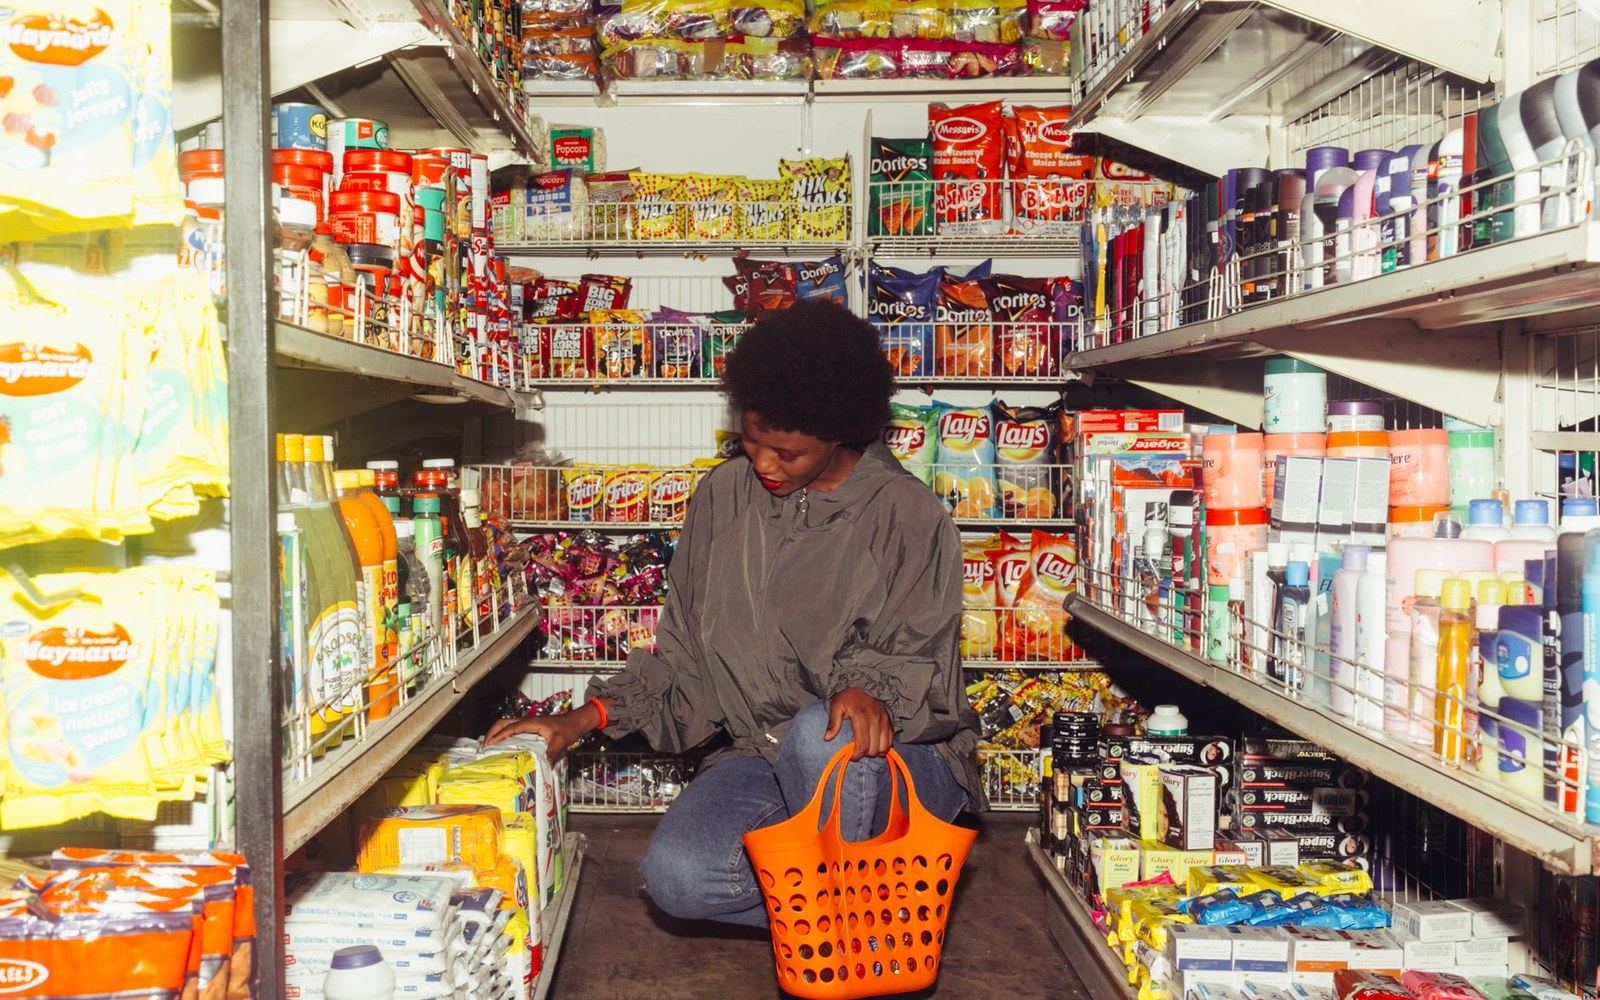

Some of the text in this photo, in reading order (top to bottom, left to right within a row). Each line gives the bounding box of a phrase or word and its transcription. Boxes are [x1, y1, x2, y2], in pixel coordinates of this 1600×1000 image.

[940, 125, 980, 135] Messaris
[556, 144, 588, 156] Popcorn
[871, 157, 927, 174] Doritos
[952, 157, 976, 165] Snack
[1058, 159, 1082, 167] Snack
[793, 177, 828, 198] NIK
[800, 264, 838, 280] Doritos
[589, 286, 616, 301] BIG
[586, 297, 614, 308] KORN
[993, 293, 1047, 313] Doritos
[868, 299, 926, 319] Doritos
[936, 305, 992, 322] Doritos
[660, 327, 694, 338] Doritos
[553, 341, 581, 350] KORN
[553, 350, 581, 358] BITES
[941, 414, 990, 443] Lay's
[885, 424, 925, 455] ay's
[998, 421, 1046, 448] Lay's
[1135, 440, 1189, 450] Colgate
[607, 480, 644, 504] Fritos
[16, 640, 140, 666] Maynards
[1263, 769, 1331, 780] SuperBlack
[1162, 776, 1180, 788] Glory
[1263, 814, 1331, 825] SuperBlack
[1110, 855, 1133, 863] Glory
[1151, 856, 1174, 864] Glory
[1184, 857, 1207, 865] Glory
[1218, 856, 1242, 865] Glory
